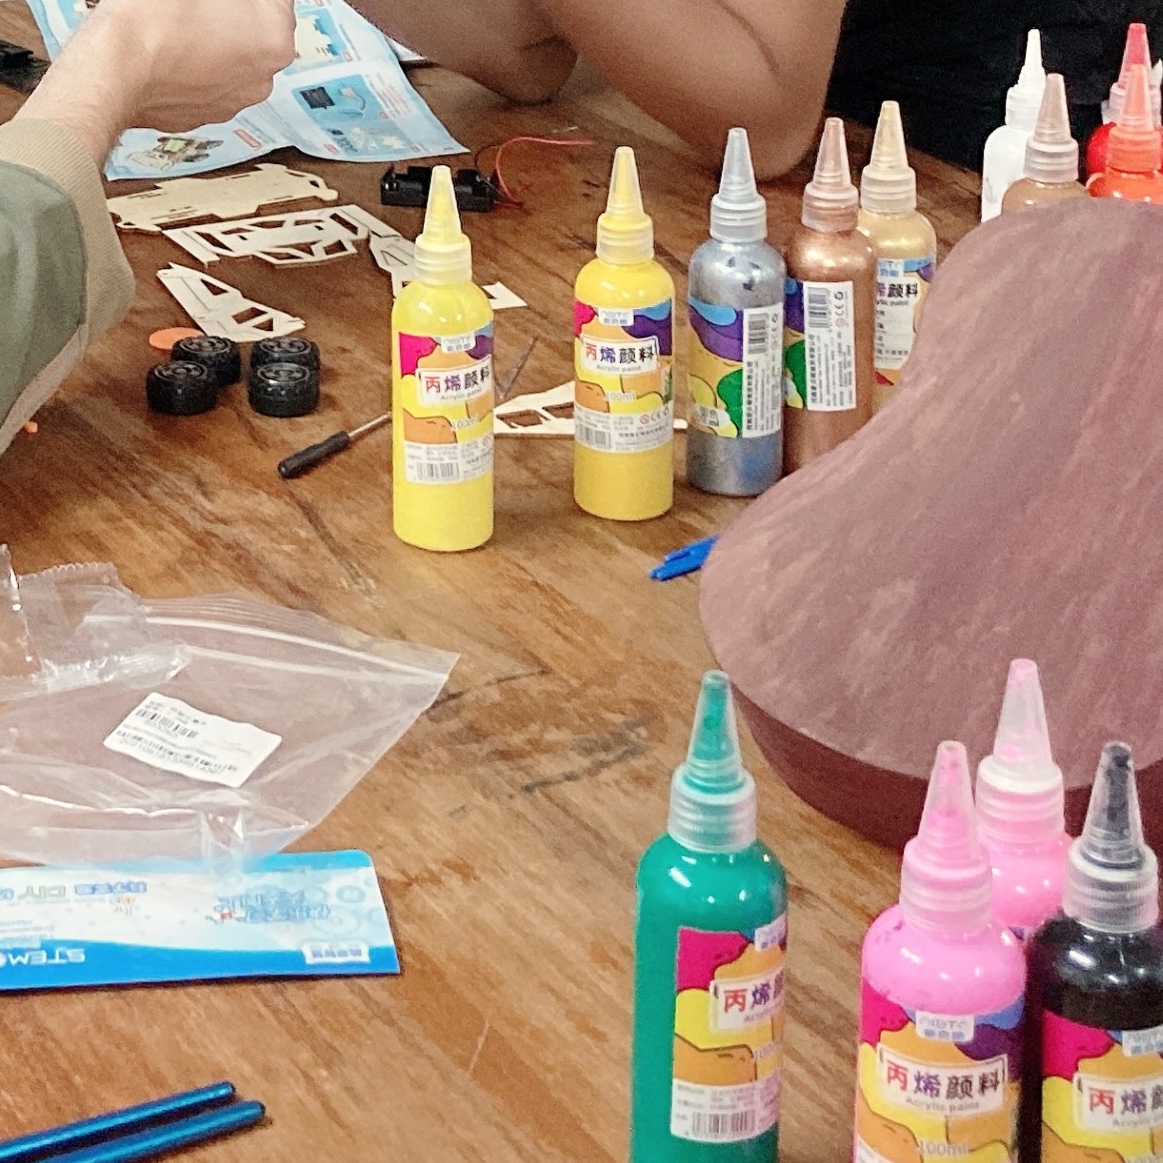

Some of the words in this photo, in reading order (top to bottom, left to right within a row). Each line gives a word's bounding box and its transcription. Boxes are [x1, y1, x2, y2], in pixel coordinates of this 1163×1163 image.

[586, 342, 654, 364] 丙烯颜料
[887, 1061, 1000, 1100] 丙烯颜料
[906, 1096, 945, 1111] Acrylic
[948, 1101, 980, 1113] paint
[920, 1141, 968, 1157] 100ml
